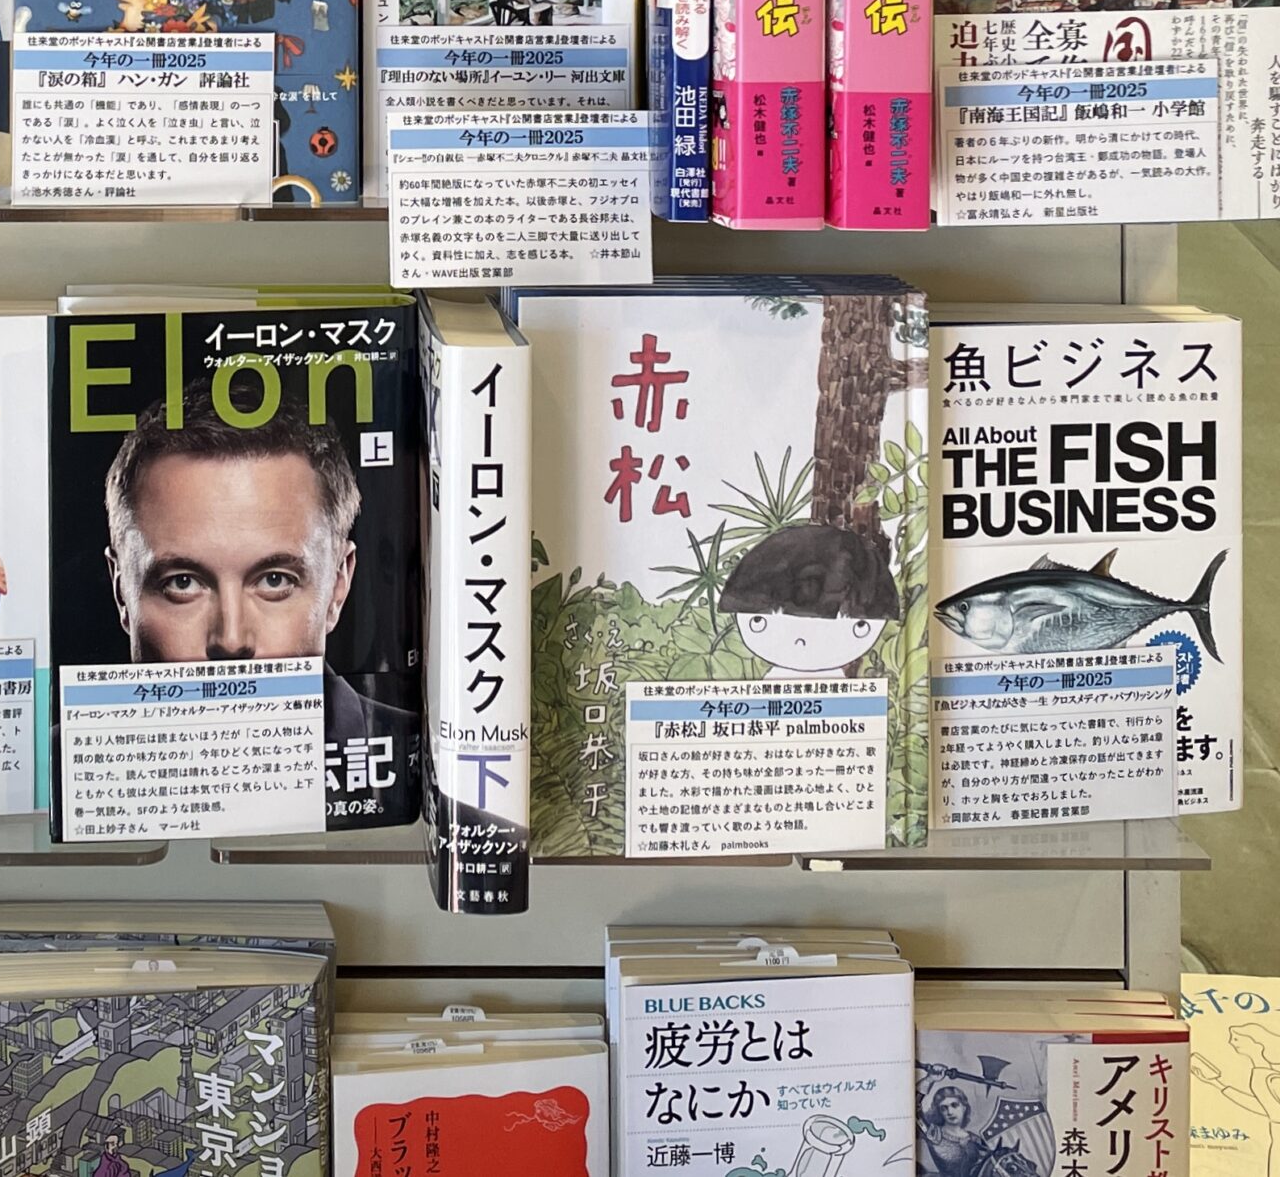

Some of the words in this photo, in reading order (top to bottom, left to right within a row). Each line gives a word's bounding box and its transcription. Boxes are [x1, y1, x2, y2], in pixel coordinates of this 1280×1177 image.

[84, 53, 207, 69] 今年の一冊2025
[444, 50, 563, 65] 今年の一冊2025
[37, 71, 107, 89] 『涙の箱』
[118, 71, 188, 88] ハン・ガン
[200, 72, 250, 89] 評論社
[571, 69, 625, 84] 河出文庫
[1018, 83, 1147, 103] 今年の一冊2025
[959, 106, 1068, 125] 『南海王国記』
[1075, 105, 1146, 121] 飯嶋和一
[1152, 100, 1205, 117] 小学館
[459, 130, 583, 146] 今年の一冊2025
[399, 178, 638, 190] 約60年間絶版になっていた赤塚不二夫の初エッセイ
[400, 231, 640, 243] 赤塚名義の文字ものを二人三脚で大量に送り出して
[204, 318, 396, 351] イーロン・マスク
[70, 312, 374, 433] Elon
[943, 337, 1218, 393] 魚ビジネス
[605, 333, 691, 523] 赤松
[942, 427, 970, 446] All
[974, 426, 1037, 445] About
[364, 437, 390, 463] 上
[942, 447, 1037, 488] THE
[1050, 420, 1217, 484] FISH
[942, 486, 1217, 539] BUSINESS
[464, 362, 508, 714] イーロン・マスク
[133, 682, 257, 700] 今年の一冊2025
[998, 671, 1112, 692] 今年の一冊2025
[700, 700, 823, 717] 今年の一冊2025
[73, 726, 314, 746] あまり人物評伝は読まないほうだが「この人物は人
[440, 721, 475, 742] Elon
[482, 722, 528, 742] Musk
[654, 721, 707, 738] 『赤松』
[712, 720, 781, 738] 坂口恭平
[786, 719, 865, 736] palmbooks
[941, 715, 1163, 737] 書店営業のたびに気になっていた書籍で、刊行から
[575, 662, 619, 817] 坂口恭平
[74, 744, 314, 764] 類の敵なのか味方なのか」今年ひどく気になって手
[638, 746, 876, 762] 坂口さんの絵が好きな方、おはなしが好きな方、歌
[941, 749, 1164, 771] は必読です。神経締めと冷凍保存の話が出てきます
[457, 754, 511, 810] 下
[638, 764, 875, 780] が好きな方、その持ち味が全部つまった一冊ができ
[942, 767, 1164, 789] が、自分のやり方が間違っていなかったことがわか
[75, 779, 314, 799] ともかくも彼は火星には本気で行く気らしい。上下
[638, 782, 875, 798] ました。水彩で描かれた漫画は読み心地よく、ひと
[638, 800, 875, 816] や土地の記憶がさまざまなものと共鳴し合いどこま
[439, 840, 518, 855] アイザックソン
[456, 890, 509, 902] 文藝春秋
[645, 997, 694, 1013] BLUE
[699, 994, 766, 1011] BACKS
[644, 1019, 813, 1069] 疲労とは
[777, 1079, 877, 1096] すべてはウイルスが
[645, 1080, 771, 1124] なにか
[777, 1097, 831, 1111] 知っていた
[425, 1110, 440, 1174] 中村隆之
[647, 1142, 736, 1168] 近藤一博
